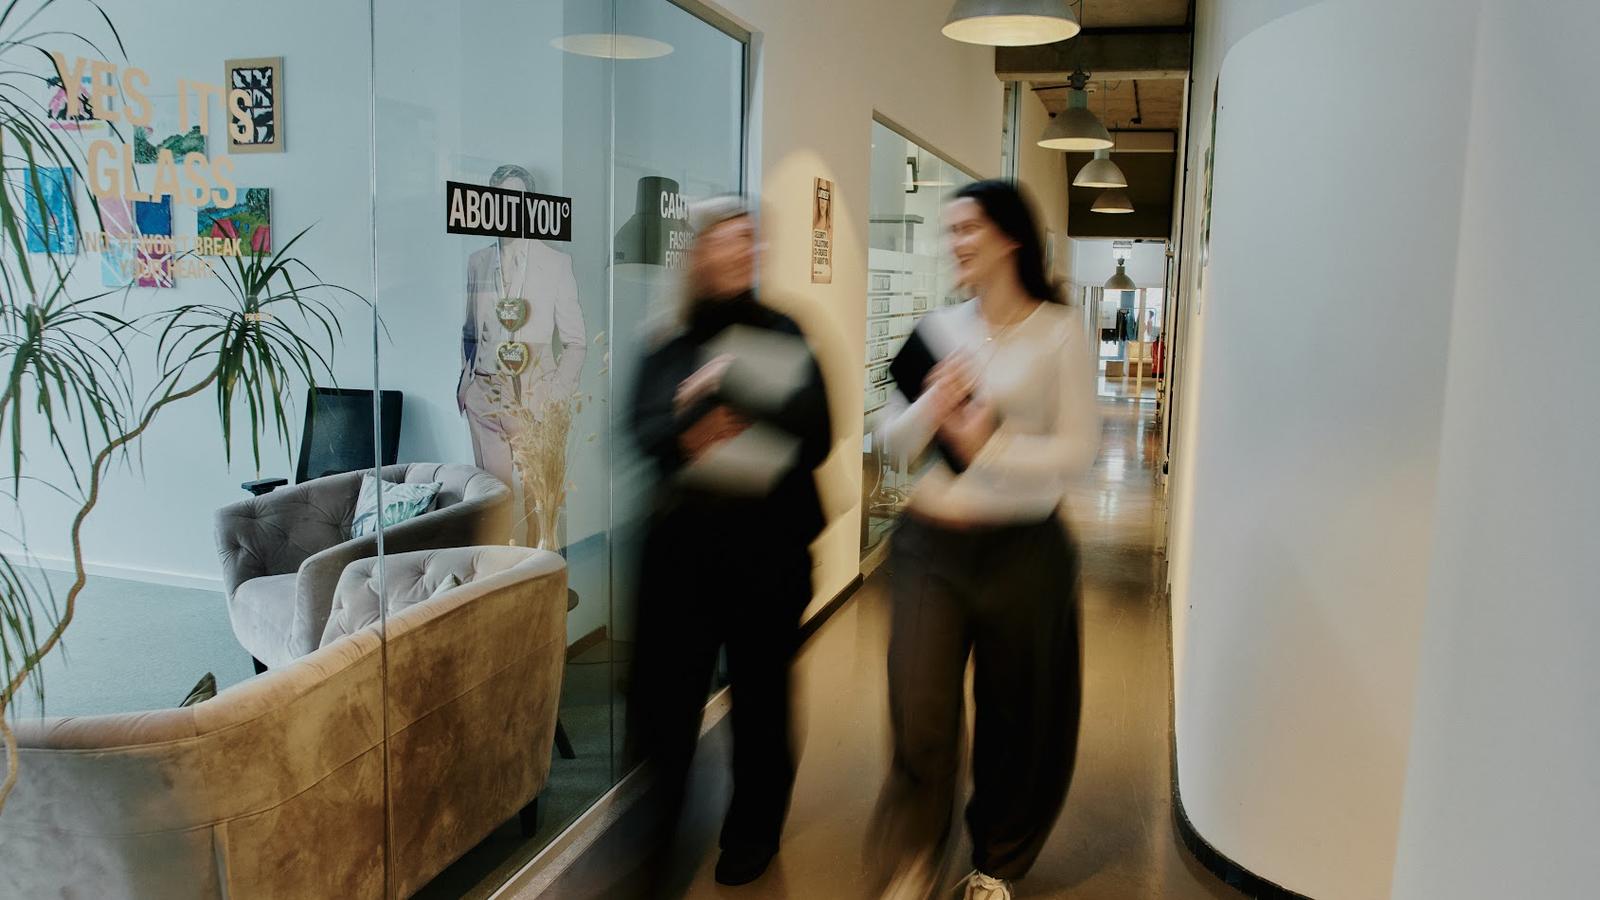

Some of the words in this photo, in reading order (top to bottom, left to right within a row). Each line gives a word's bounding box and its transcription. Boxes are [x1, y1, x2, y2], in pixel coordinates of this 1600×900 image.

[51, 50, 153, 127] YES
[177, 79, 255, 143] IT'S
[87, 140, 237, 209] GLASS
[449, 188, 520, 232] ABOUT
[660, 191, 689, 220] CAUT
[196, 236, 242, 256] BREAK
